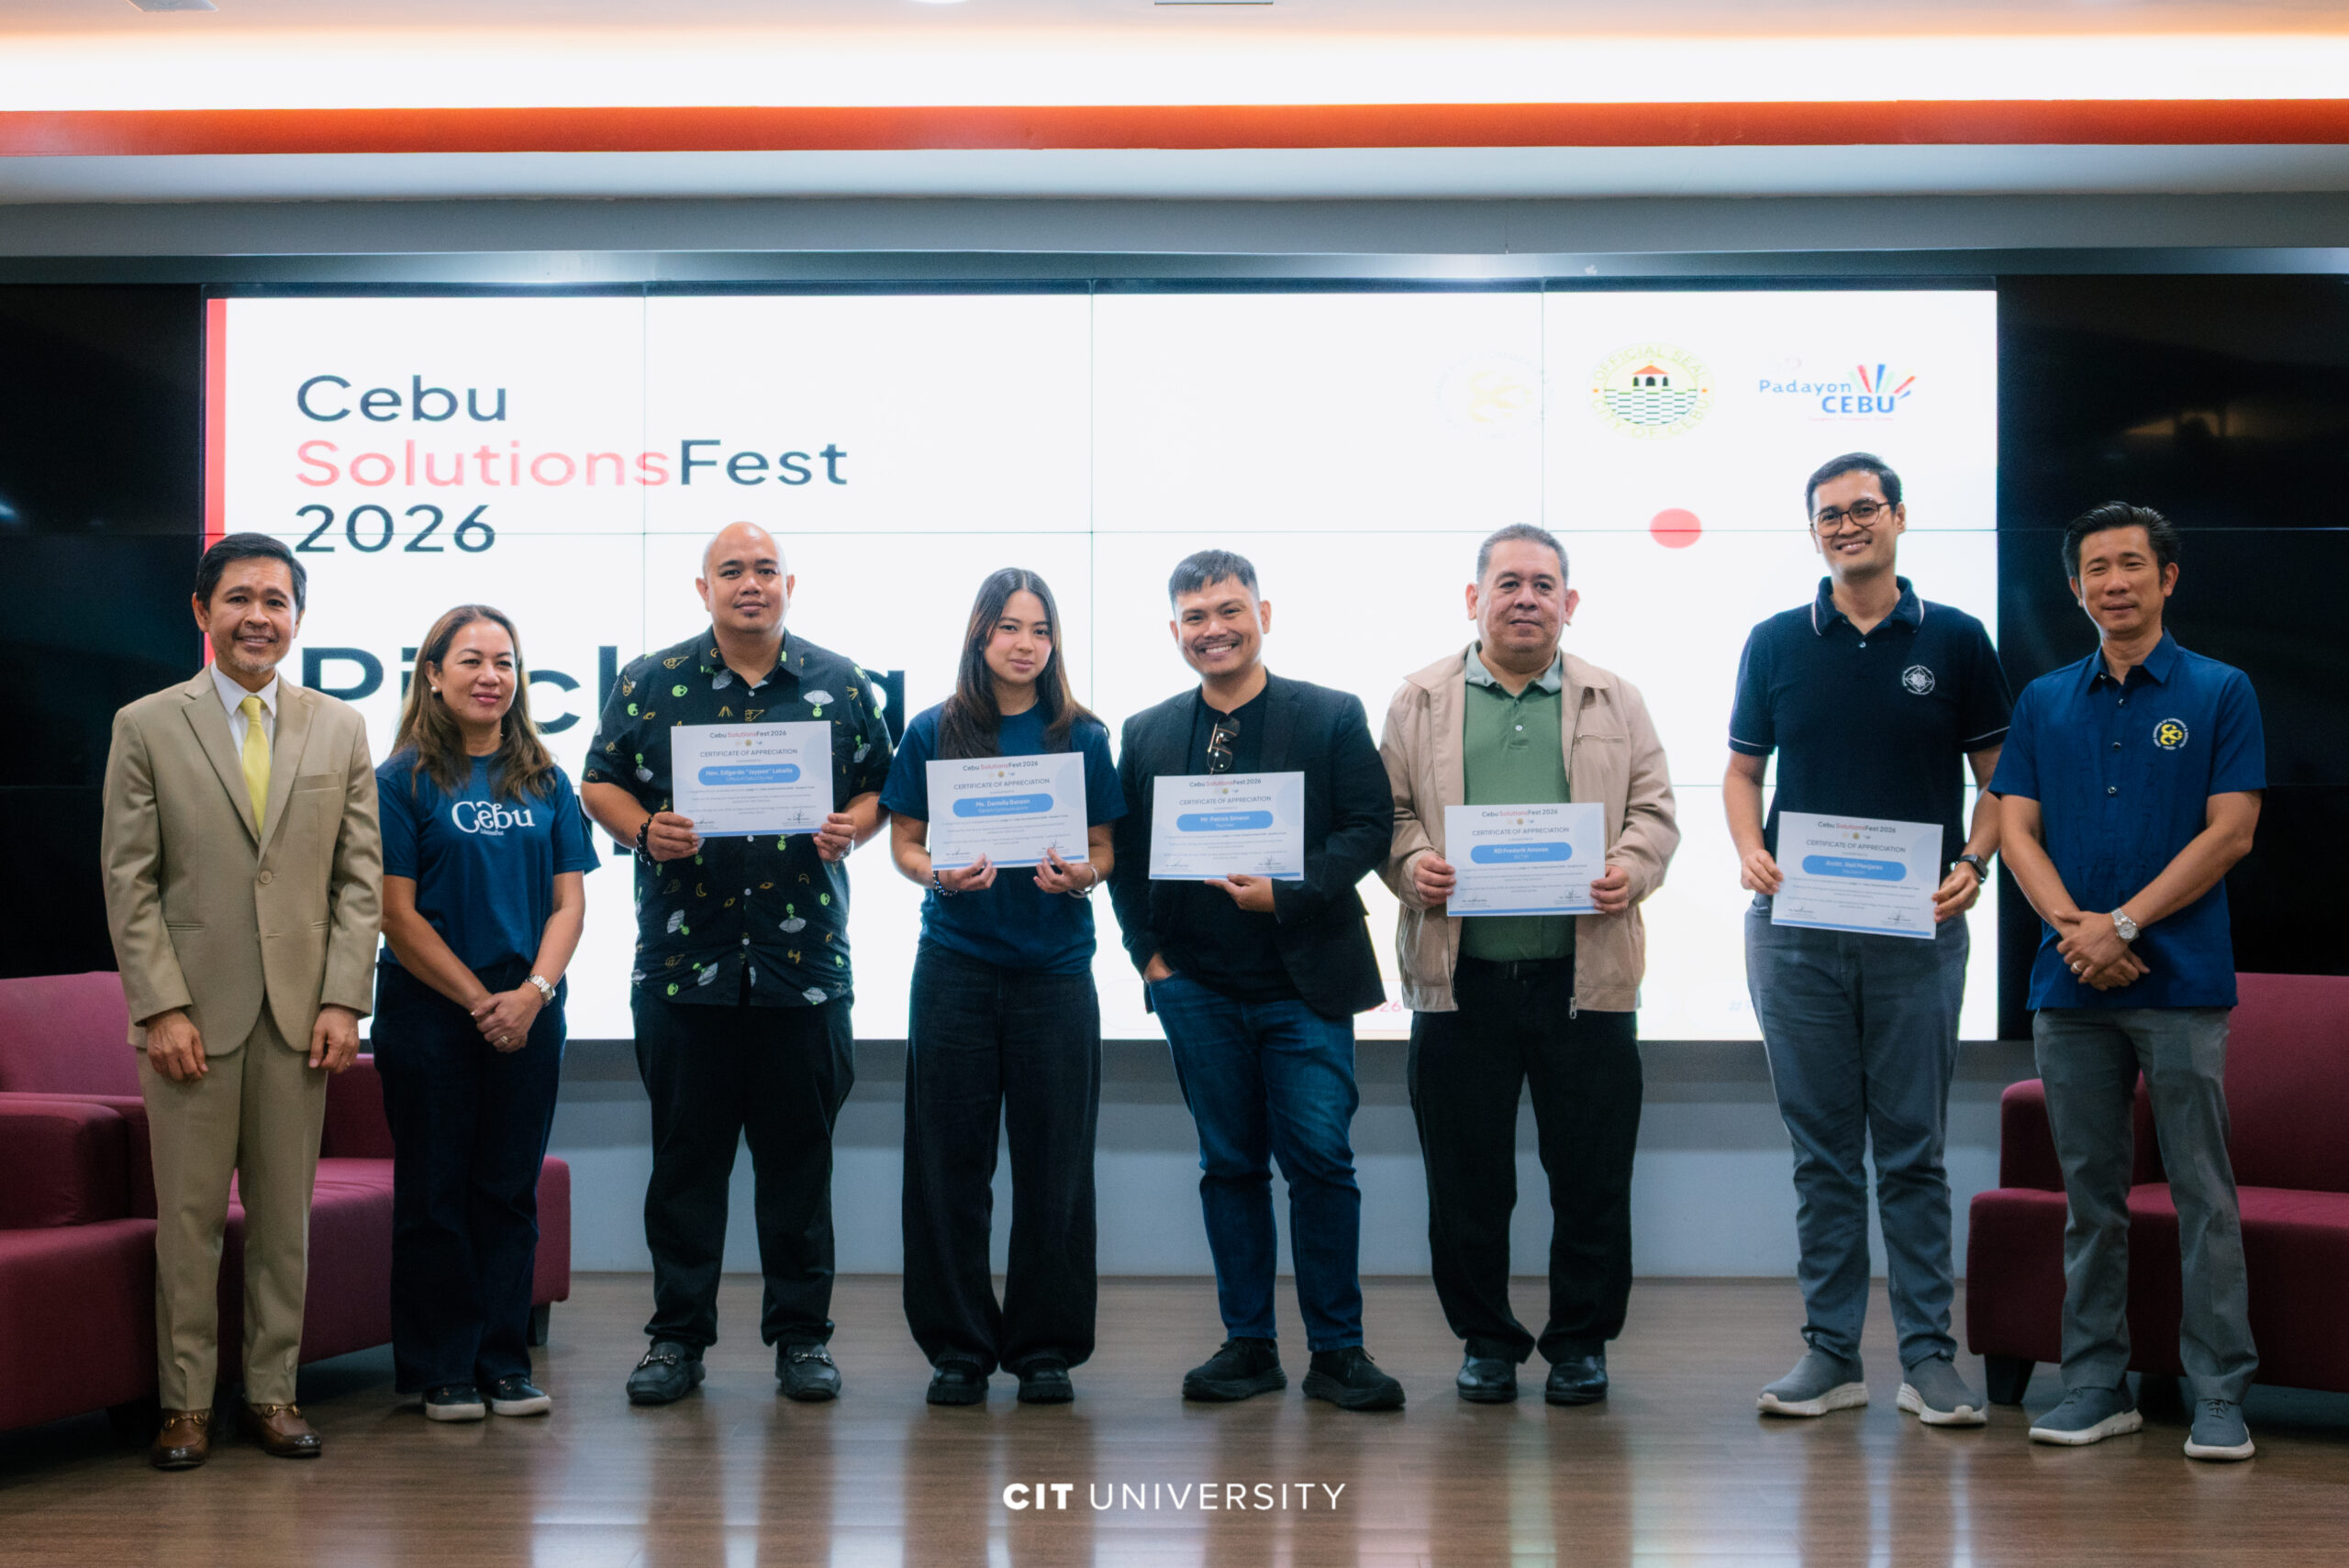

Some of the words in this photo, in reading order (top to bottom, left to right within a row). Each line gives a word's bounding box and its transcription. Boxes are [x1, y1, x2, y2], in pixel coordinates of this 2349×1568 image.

[1671, 350, 1706, 380] SEAL
[296, 374, 507, 422] Cebu
[1759, 379, 1852, 396] Padayon
[1631, 427, 1659, 439] OF
[1668, 399, 1709, 435] CEBU
[1820, 395, 1896, 414] CEBU
[296, 439, 848, 486] SolutionsFest
[295, 504, 496, 553] 2026
[954, 782, 993, 790] CERTIFICATE
[1004, 778, 1050, 787] APPRECIATION
[1228, 795, 1271, 804] APPRECIATION
[451, 800, 536, 833] Cebu
[1807, 840, 1845, 848] CERTIFICATE
[1858, 843, 1906, 853] APPRECIATION
